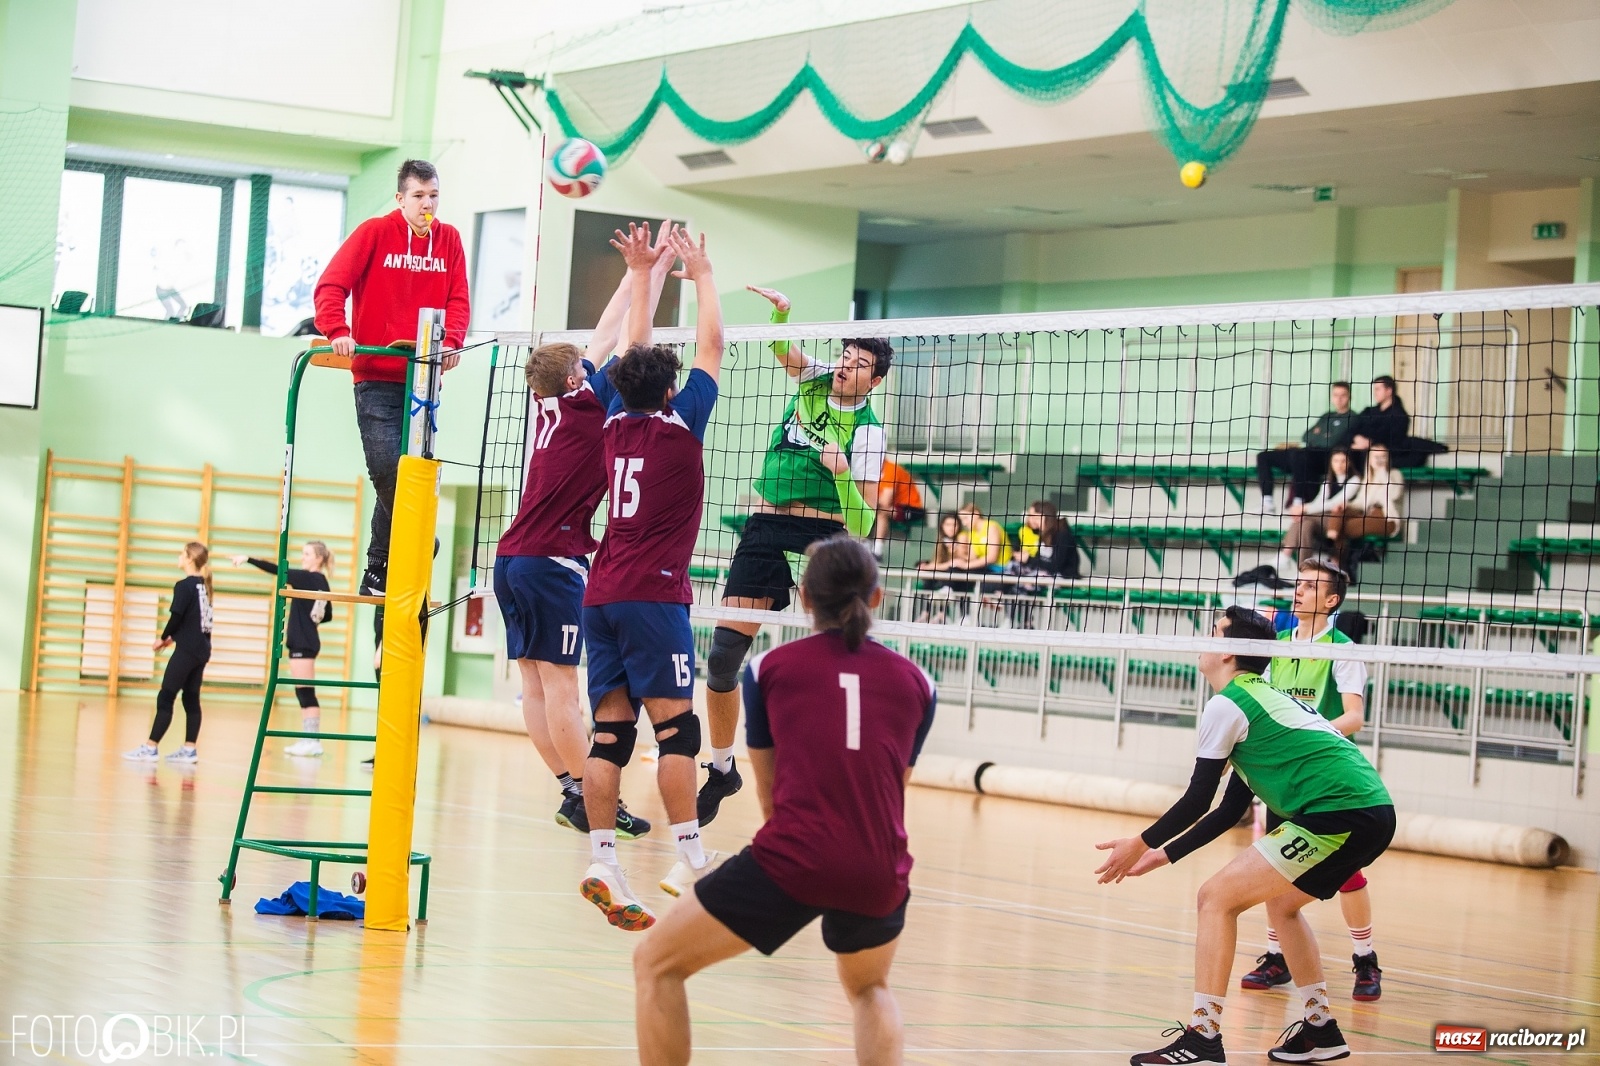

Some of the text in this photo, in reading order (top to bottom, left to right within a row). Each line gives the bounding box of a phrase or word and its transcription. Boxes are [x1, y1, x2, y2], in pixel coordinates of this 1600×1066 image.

[383, 253, 447, 272] ANTISOCIAL
[536, 396, 562, 449] 17
[612, 457, 645, 518] 15
[561, 625, 579, 655] 17
[671, 653, 692, 687] 15
[838, 672, 861, 751] 1
[678, 832, 699, 842] FILA
[1280, 835, 1310, 860] 8
